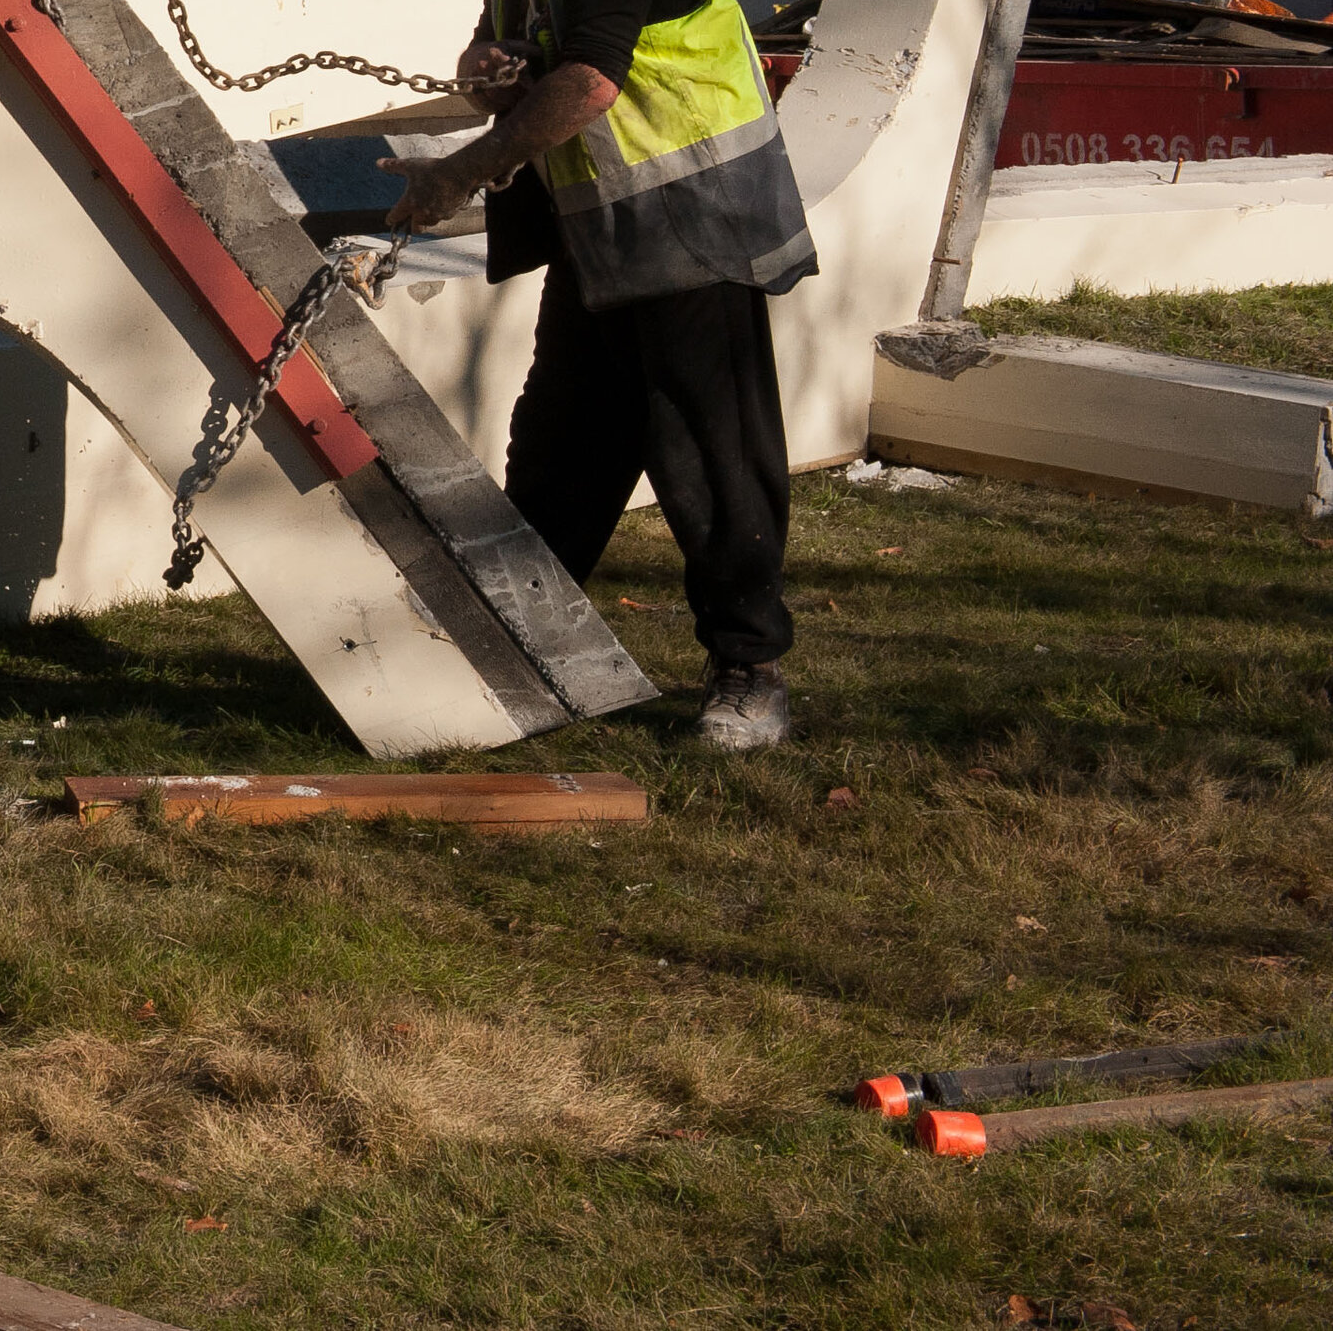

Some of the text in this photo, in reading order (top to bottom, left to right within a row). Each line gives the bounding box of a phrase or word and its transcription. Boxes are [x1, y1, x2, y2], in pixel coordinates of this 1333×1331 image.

[1021, 132, 1275, 166] 0508 336 654
